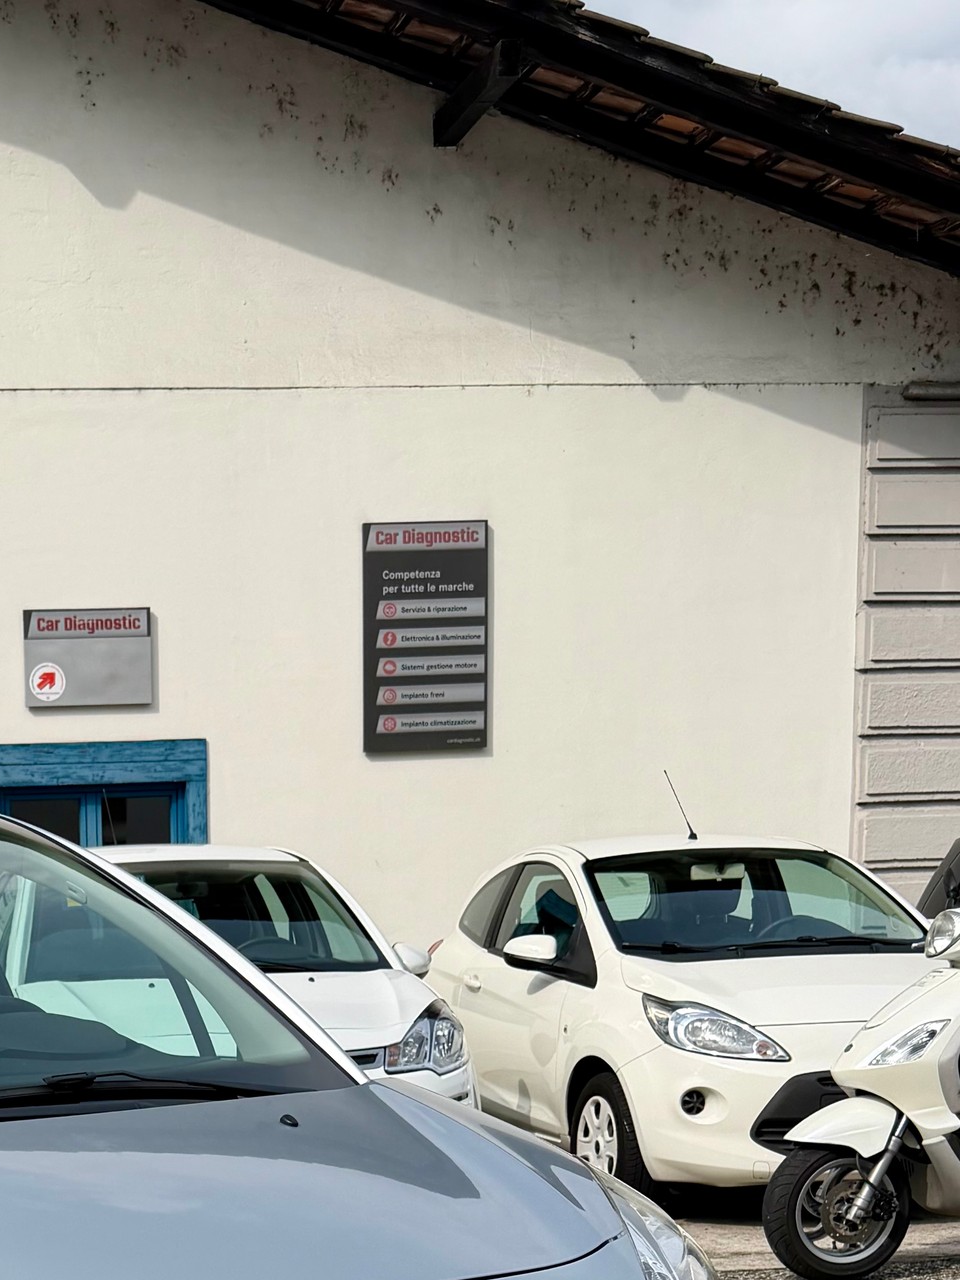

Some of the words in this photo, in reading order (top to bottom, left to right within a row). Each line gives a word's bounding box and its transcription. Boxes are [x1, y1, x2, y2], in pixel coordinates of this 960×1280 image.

[375, 530, 399, 545] Car
[402, 526, 480, 547] Diagnostic
[382, 570, 441, 581] Competenza
[382, 586, 398, 595] per
[401, 584, 425, 593] tutte
[427, 583, 436, 592] le
[438, 582, 475, 592] marche
[432, 605, 468, 613] riparazione
[36, 617, 61, 632] Car
[64, 614, 141, 634] Diagnostic
[401, 634, 435, 642] Elettronica
[441, 633, 481, 641] illuminazione
[401, 663, 425, 671] Sistemi
[426, 662, 453, 672] gestione
[401, 692, 429, 700] Impianto
[430, 690, 445, 698] freni
[401, 720, 429, 728] Impianto
[430, 718, 477, 727] climatizzazione
